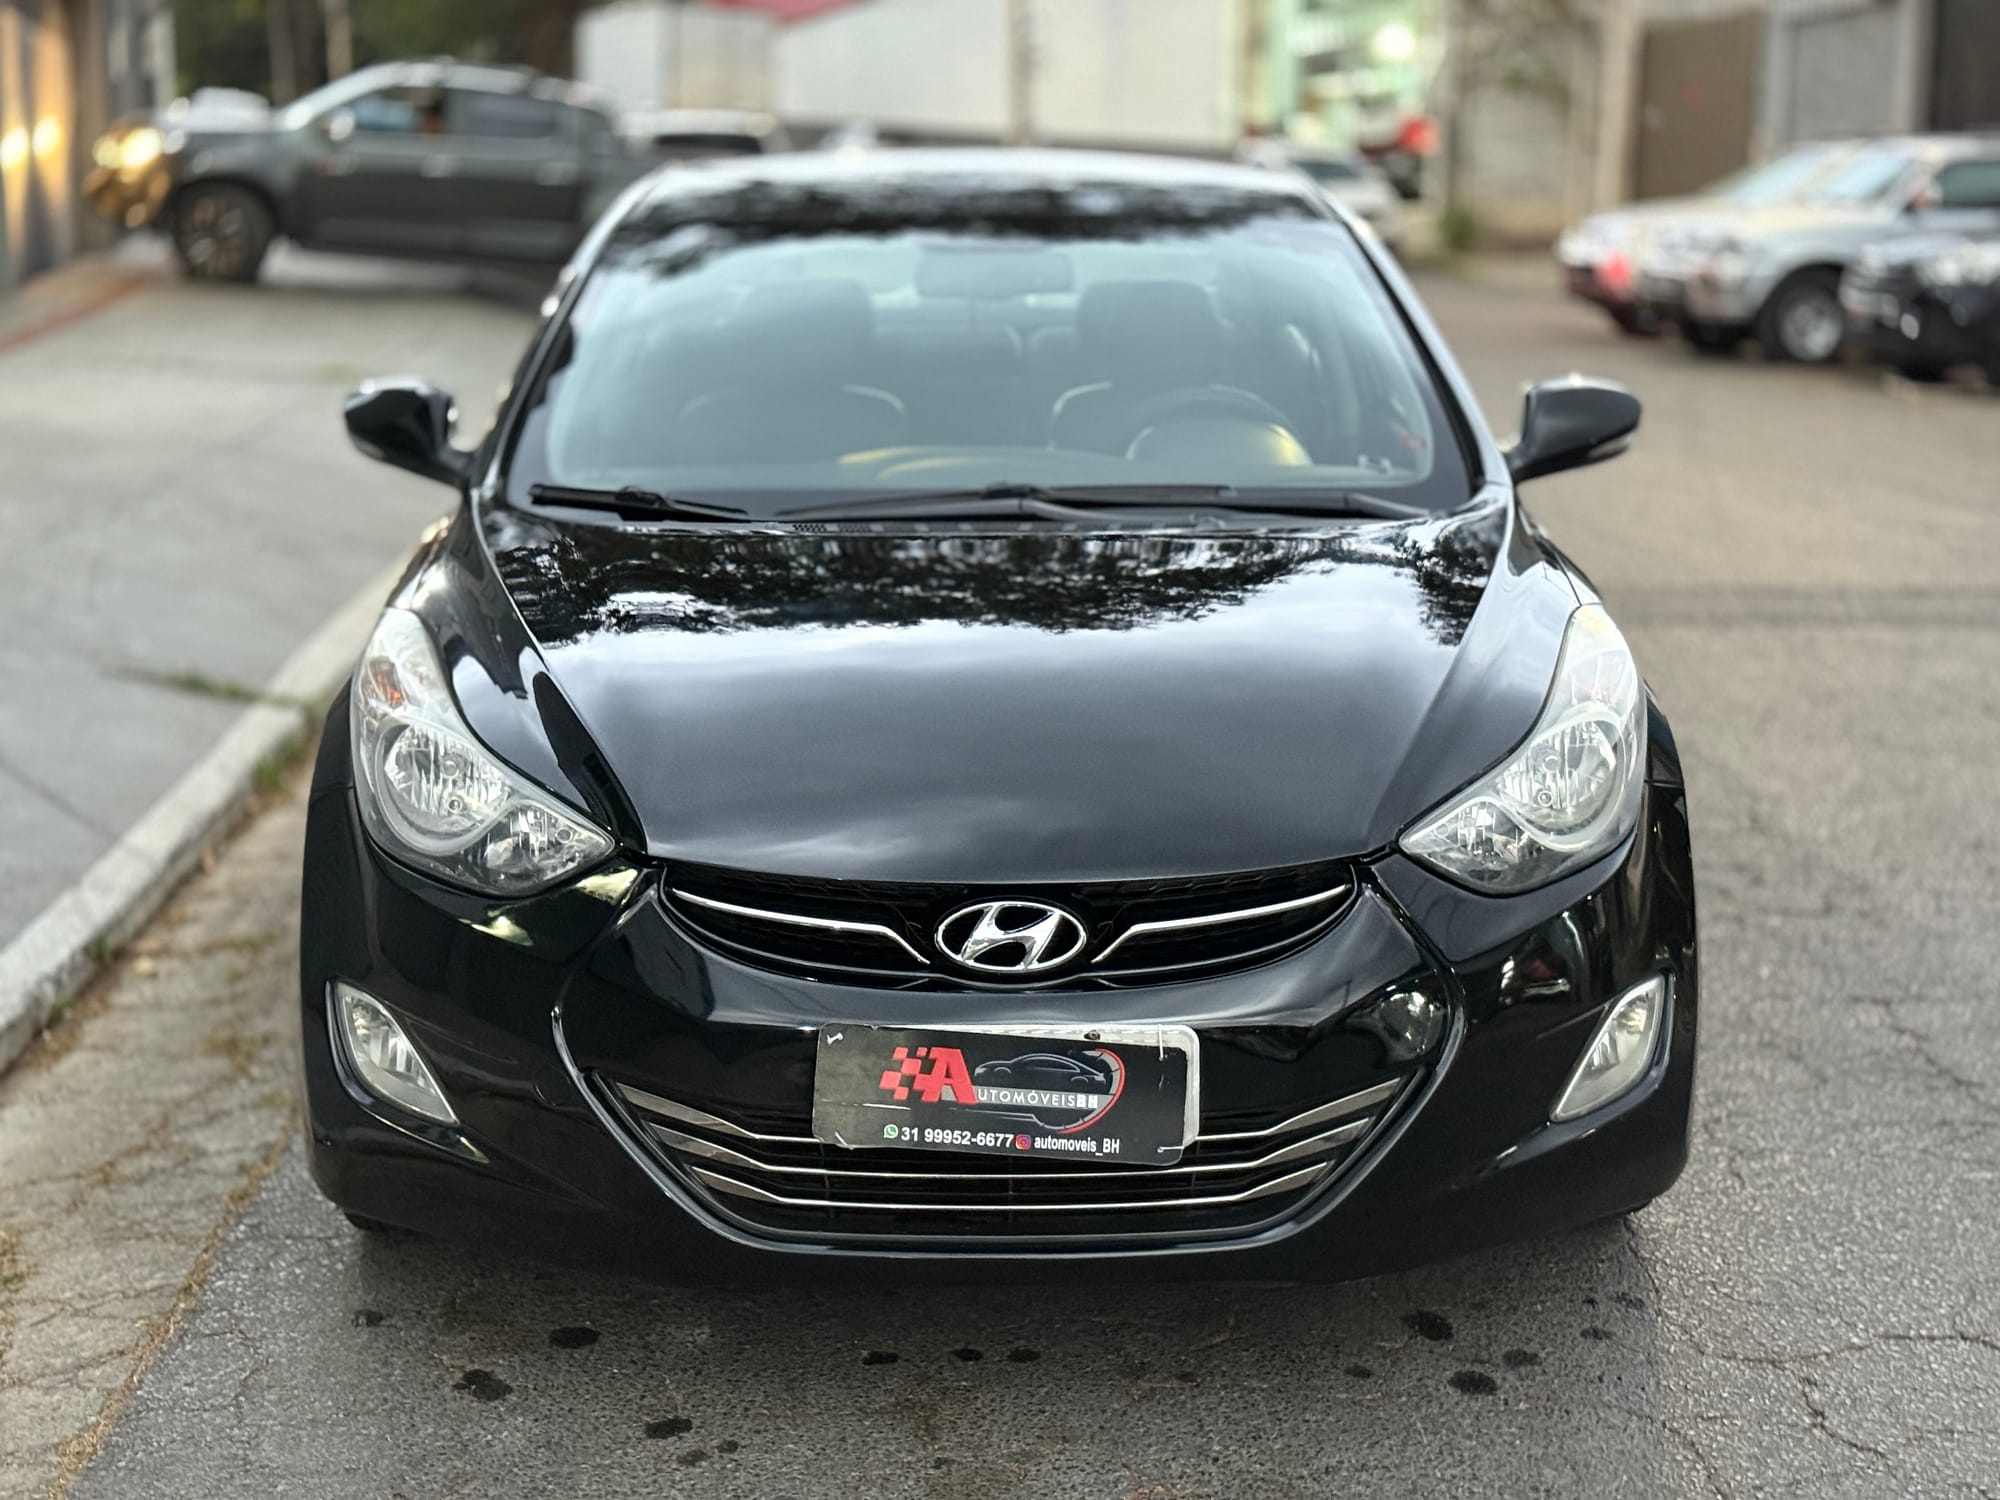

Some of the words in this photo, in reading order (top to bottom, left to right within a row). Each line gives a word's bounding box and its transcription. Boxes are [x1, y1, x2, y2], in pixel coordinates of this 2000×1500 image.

[901, 1126, 919, 1142] 31
[924, 1128, 1014, 1148] 99952-6677
[1034, 1135, 1120, 1156] automoveis_BH
